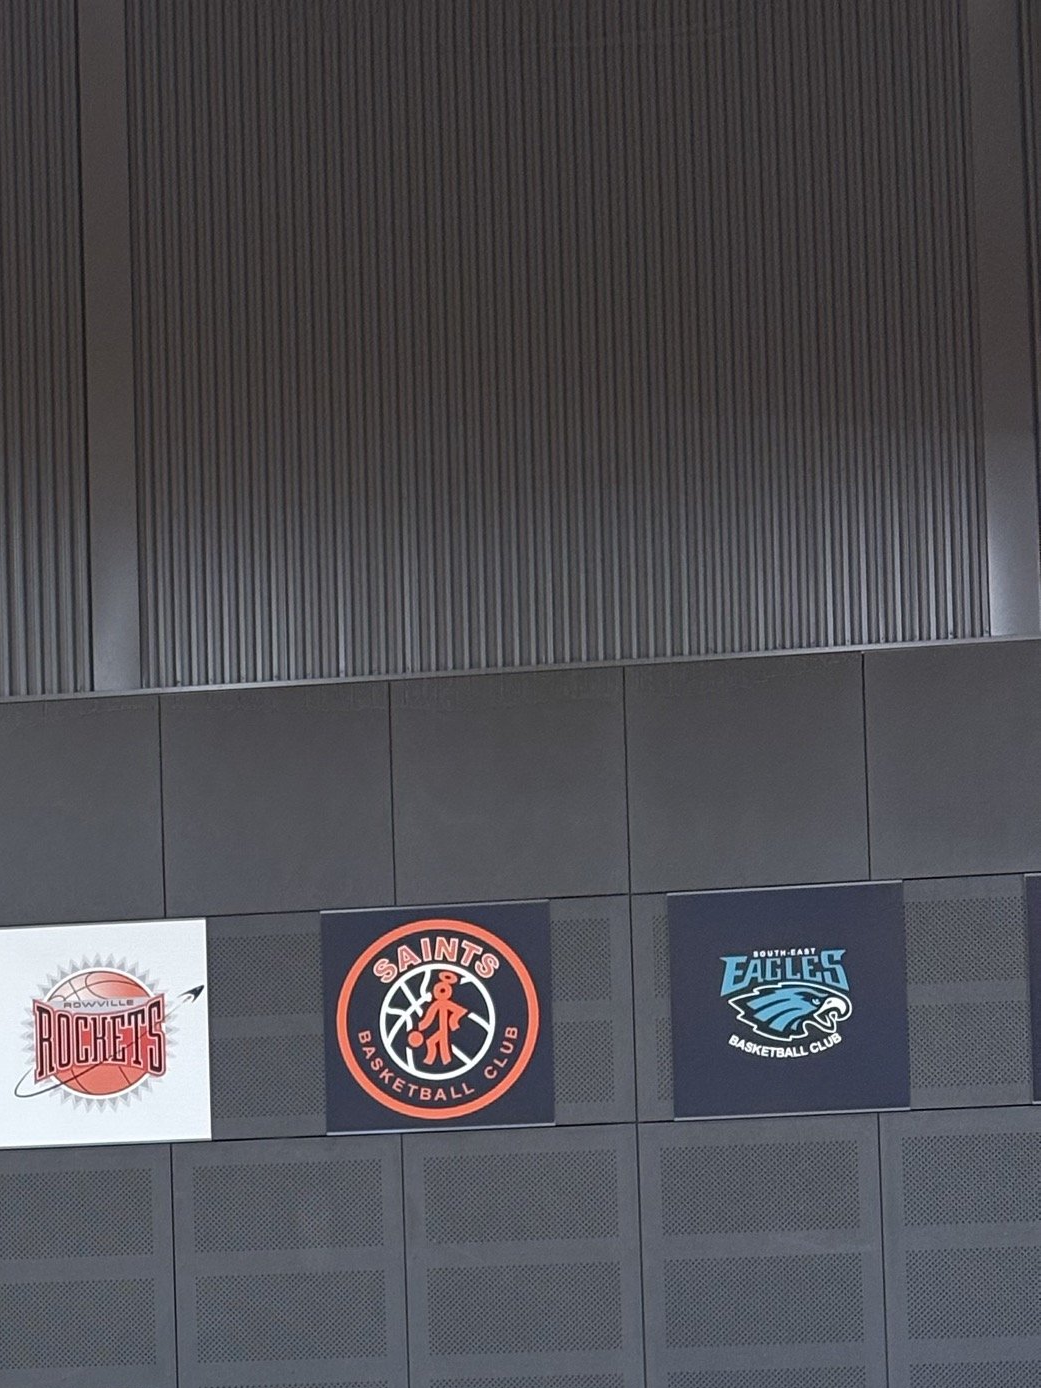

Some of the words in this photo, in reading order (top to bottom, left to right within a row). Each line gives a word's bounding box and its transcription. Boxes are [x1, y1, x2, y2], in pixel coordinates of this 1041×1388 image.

[373, 936, 500, 983] SAINTS
[719, 949, 850, 996] EAGLES
[753, 948, 816, 958] SOUTH-EAST
[63, 999, 134, 1009] ROWVILLE
[35, 999, 164, 1078] ROCKETS
[728, 1034, 809, 1058] BASKETBALL
[809, 1032, 842, 1053] CLUB
[358, 1030, 475, 1101] BASKETBALL
[484, 1026, 518, 1080] CLUB
